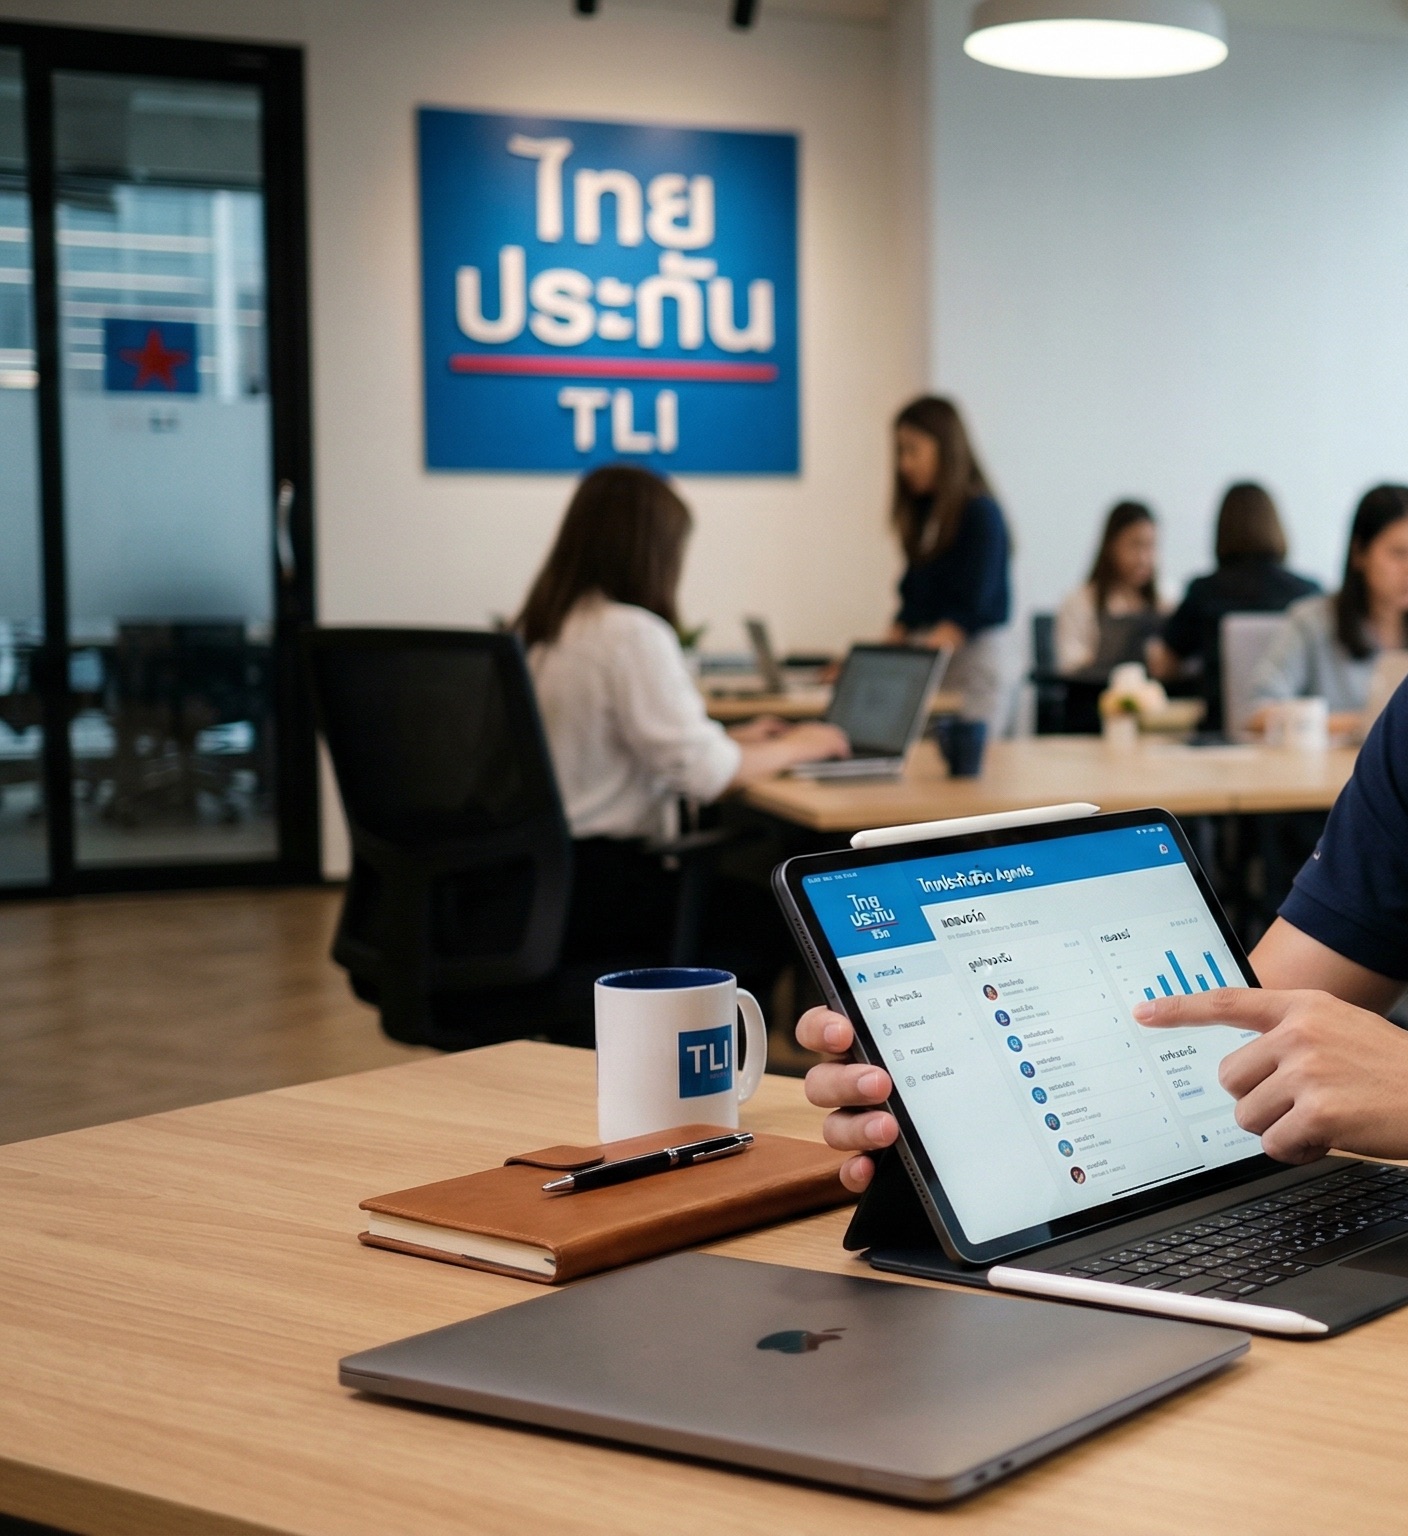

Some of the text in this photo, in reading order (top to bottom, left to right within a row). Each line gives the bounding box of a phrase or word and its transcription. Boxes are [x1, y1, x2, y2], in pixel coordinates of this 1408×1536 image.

[507, 133, 716, 250] ไทย
[455, 244, 776, 354] ประกัน
[557, 386, 680, 455] TLI
[686, 1040, 728, 1074] TLI
